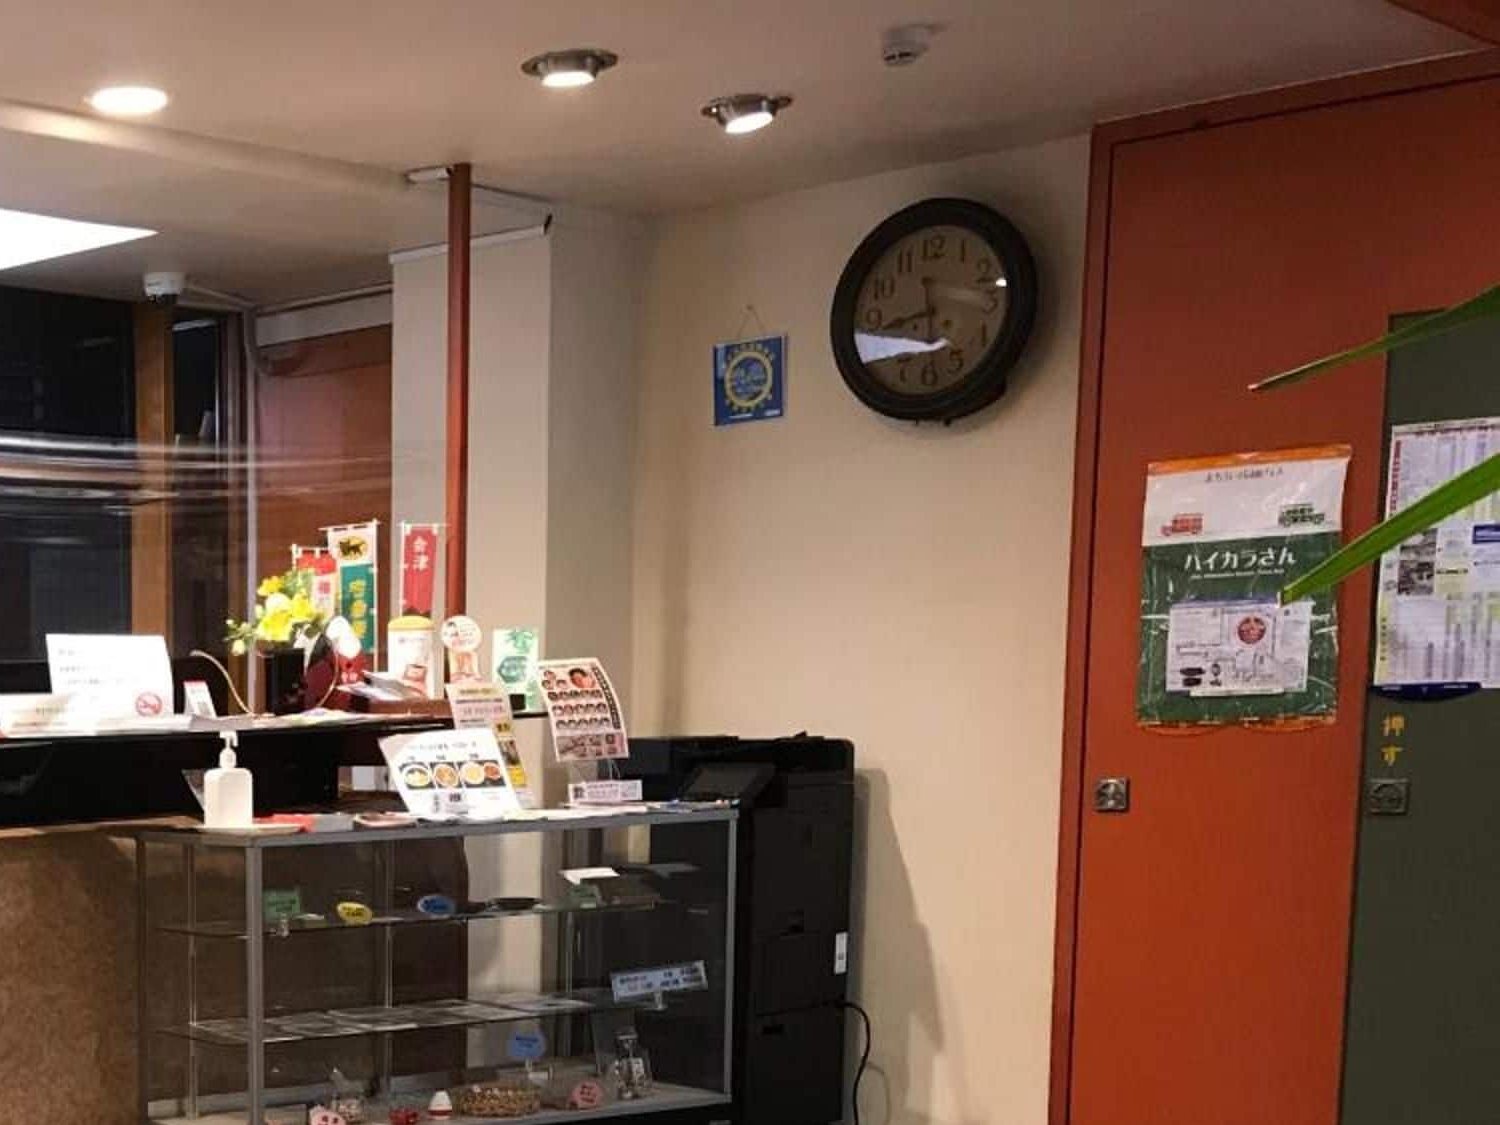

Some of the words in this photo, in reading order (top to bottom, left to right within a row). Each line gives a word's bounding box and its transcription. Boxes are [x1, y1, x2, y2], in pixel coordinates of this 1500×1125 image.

[899, 249, 913, 273] 11
[922, 235, 945, 262] 12
[976, 257, 997, 285] 2
[873, 276, 895, 300] 10
[980, 287, 998, 315] 3
[865, 307, 883, 332] 9
[949, 347, 965, 374] 5
[921, 362, 938, 386] 6
[1184, 547, 1297, 571] ハイカラさん
